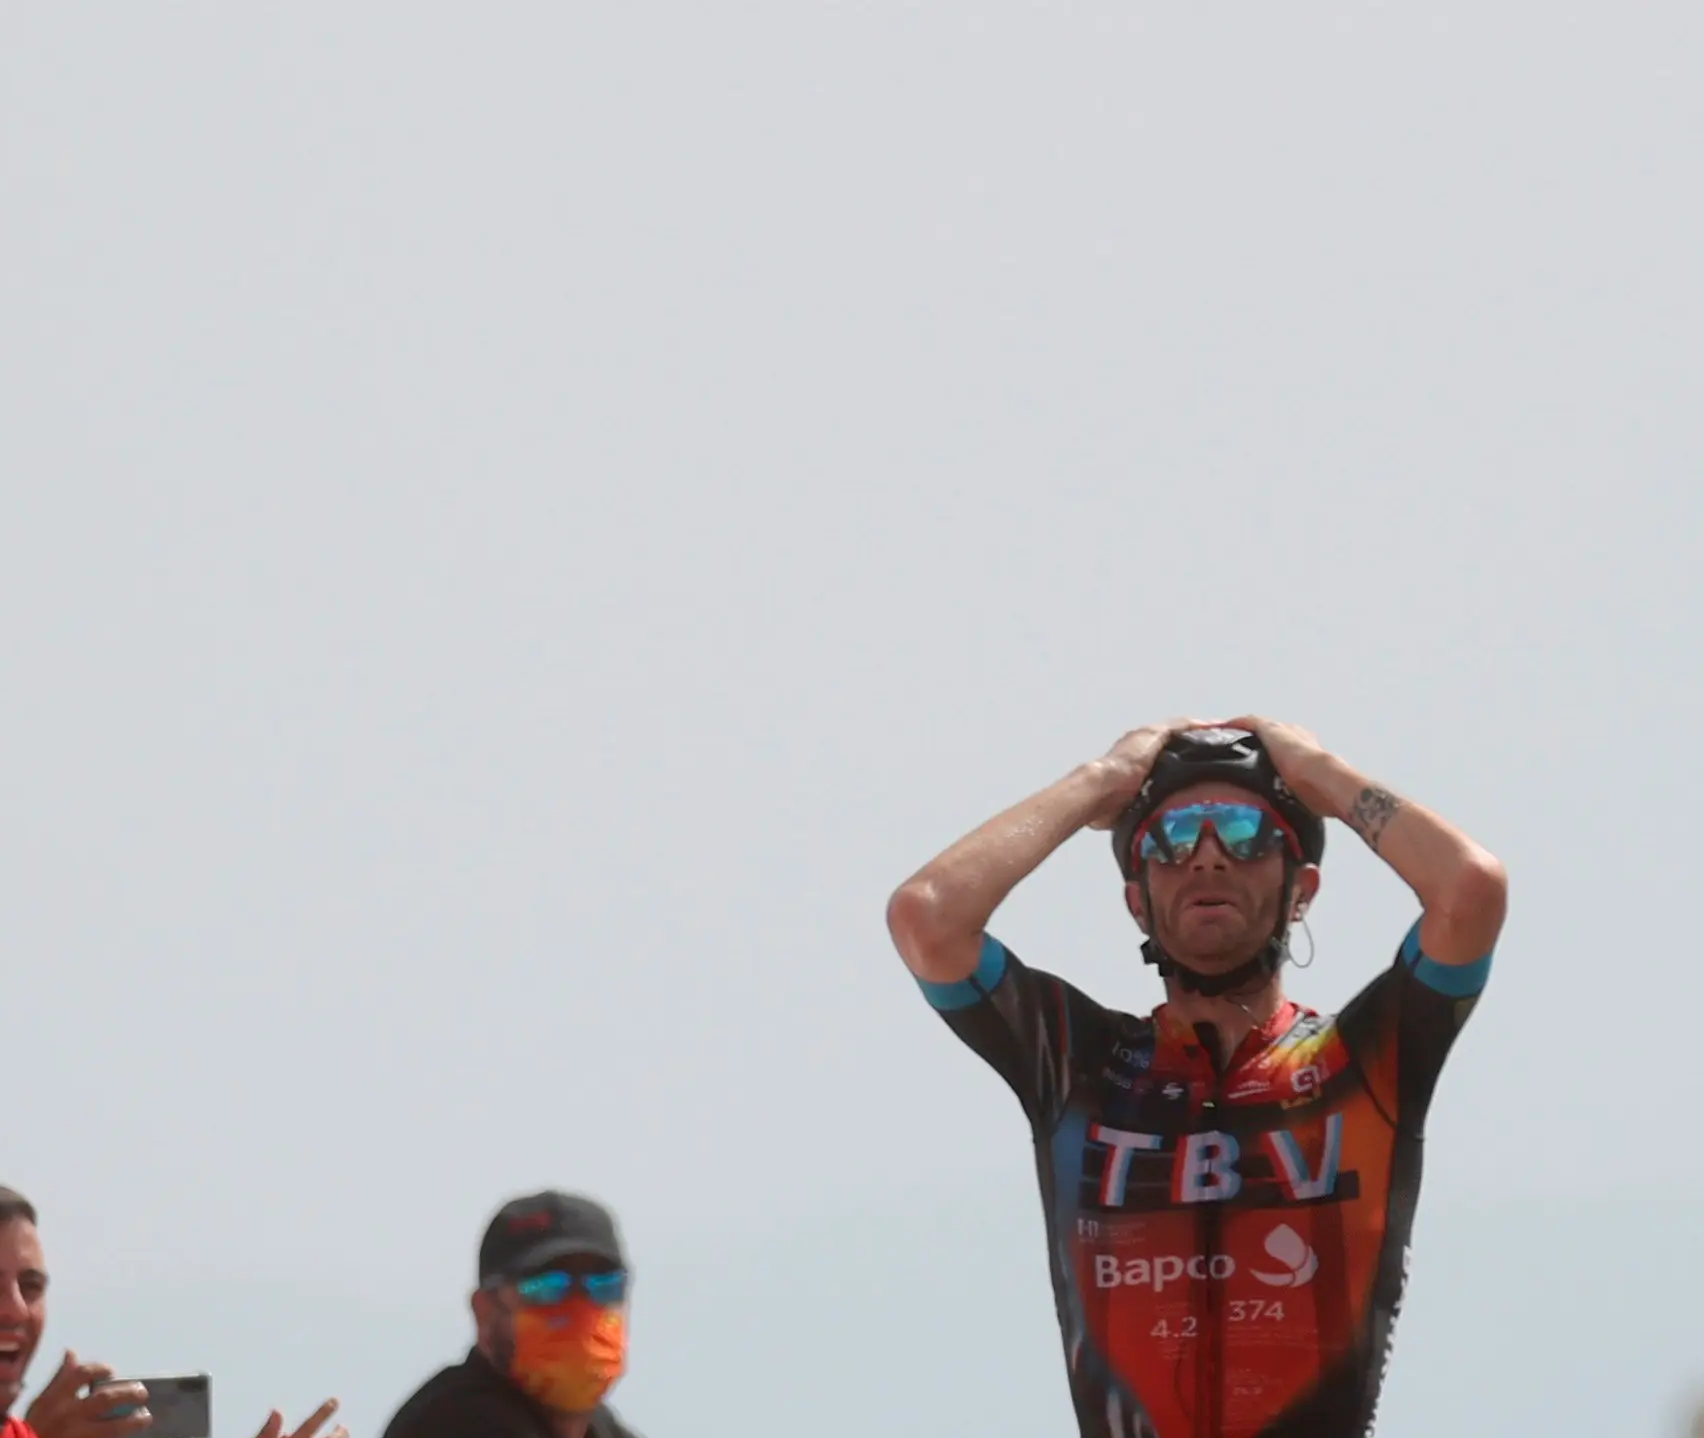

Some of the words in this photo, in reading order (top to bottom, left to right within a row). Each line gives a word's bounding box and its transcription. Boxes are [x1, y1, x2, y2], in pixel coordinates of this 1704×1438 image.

[1095, 1254, 1236, 1292] Bapco
[1227, 1300, 1285, 1322] 374
[1149, 1316, 1199, 1338] 4.2
